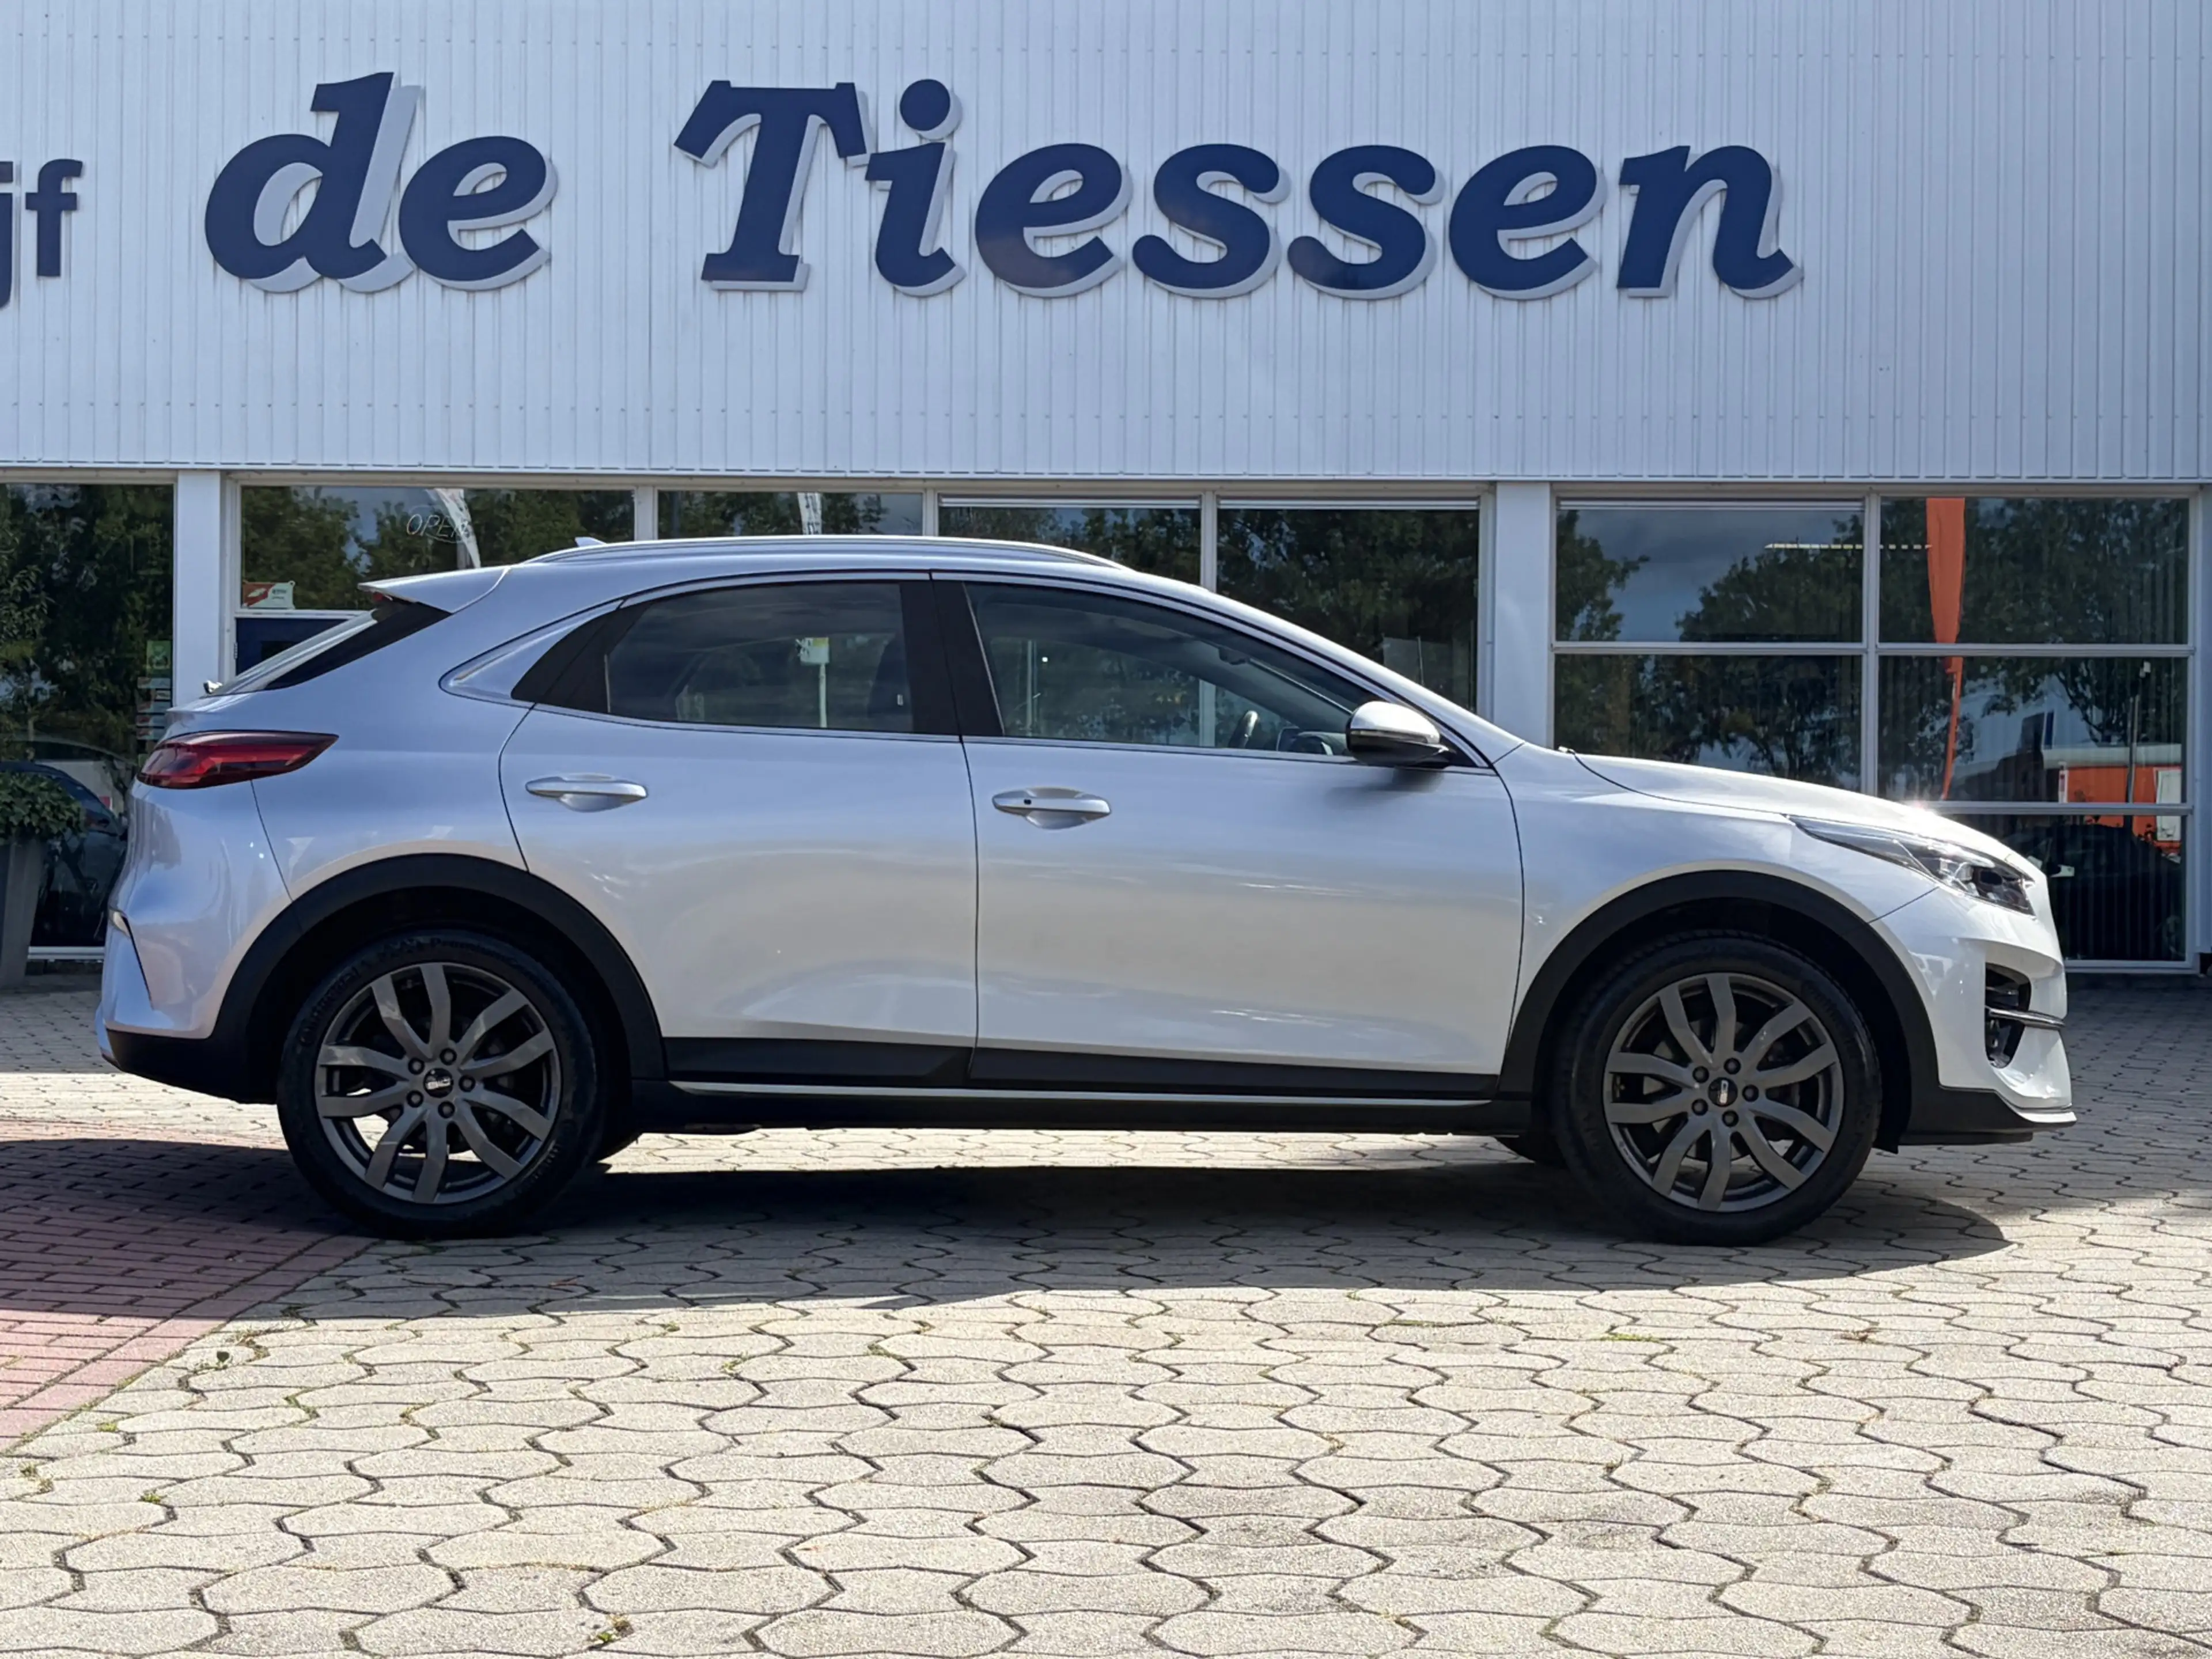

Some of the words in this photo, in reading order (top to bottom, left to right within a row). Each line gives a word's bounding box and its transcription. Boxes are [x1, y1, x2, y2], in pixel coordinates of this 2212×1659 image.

[204, 72, 552, 296] de
[673, 79, 1800, 300] Tiessen
[406, 513, 468, 538] OPEN
